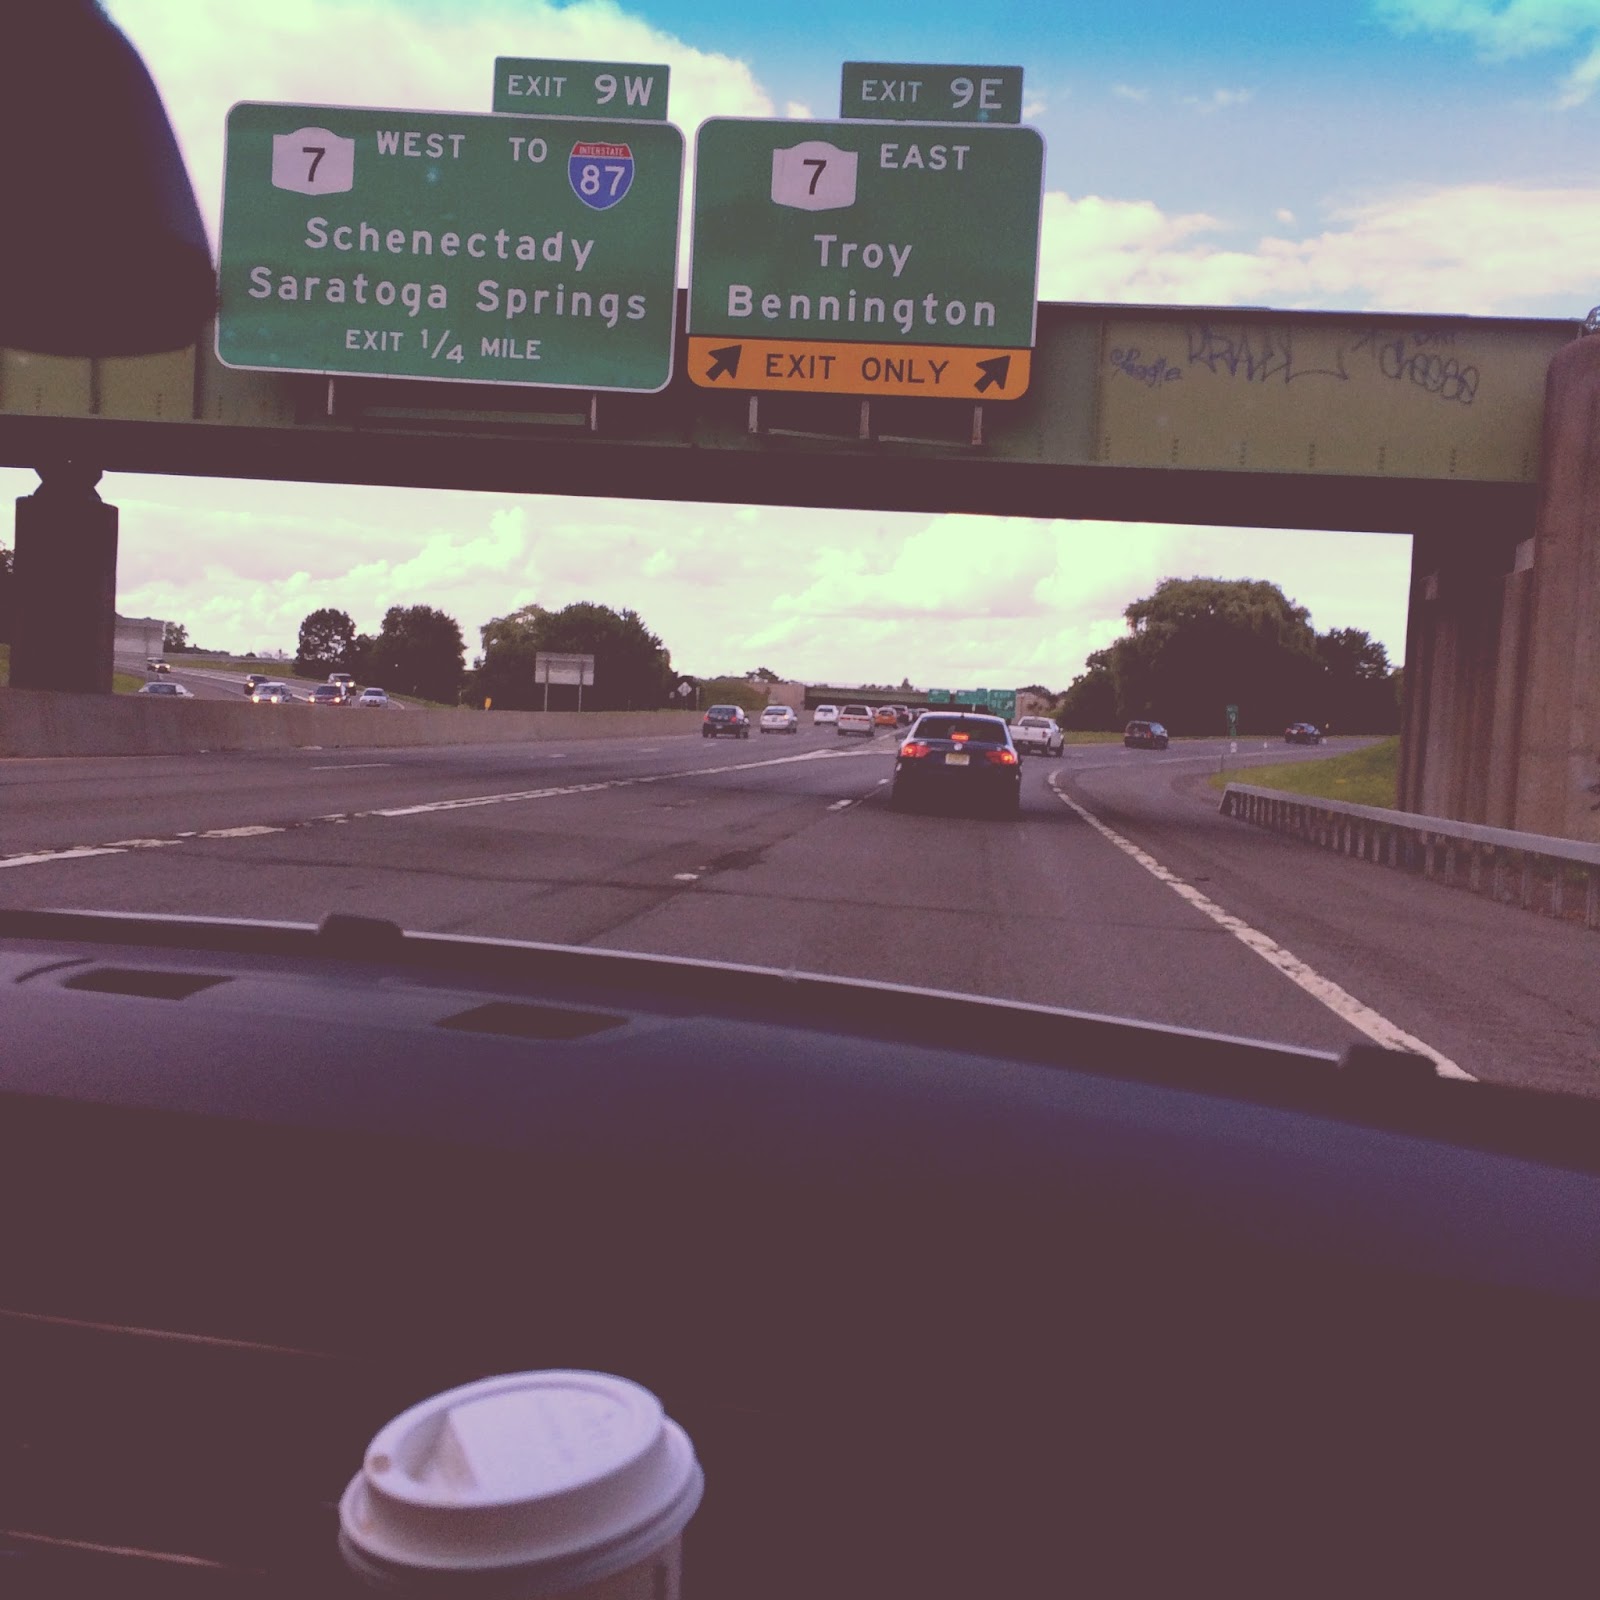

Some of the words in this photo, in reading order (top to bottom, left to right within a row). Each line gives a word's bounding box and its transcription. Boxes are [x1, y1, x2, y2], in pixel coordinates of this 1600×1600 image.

[507, 74, 567, 98] EXIT
[594, 74, 654, 107] 9W
[861, 79, 923, 103] EXIT
[950, 77, 1003, 110] 9E
[376, 130, 466, 159] WEST
[508, 137, 548, 163] TO
[579, 145, 625, 156] INTERSTATE
[880, 143, 971, 171] EAST
[302, 146, 326, 183] 7
[580, 164, 626, 197] 87
[802, 158, 827, 196] 7
[304, 216, 595, 272] Schenectady
[813, 234, 913, 277] Troy
[248, 266, 447, 318] Saratoga
[475, 279, 646, 329] Springs
[727, 284, 996, 335] Bennington
[345, 329, 404, 352] EXIT
[481, 336, 541, 360] MILE
[765, 353, 837, 380] EXIT
[861, 356, 950, 385] ONLY
